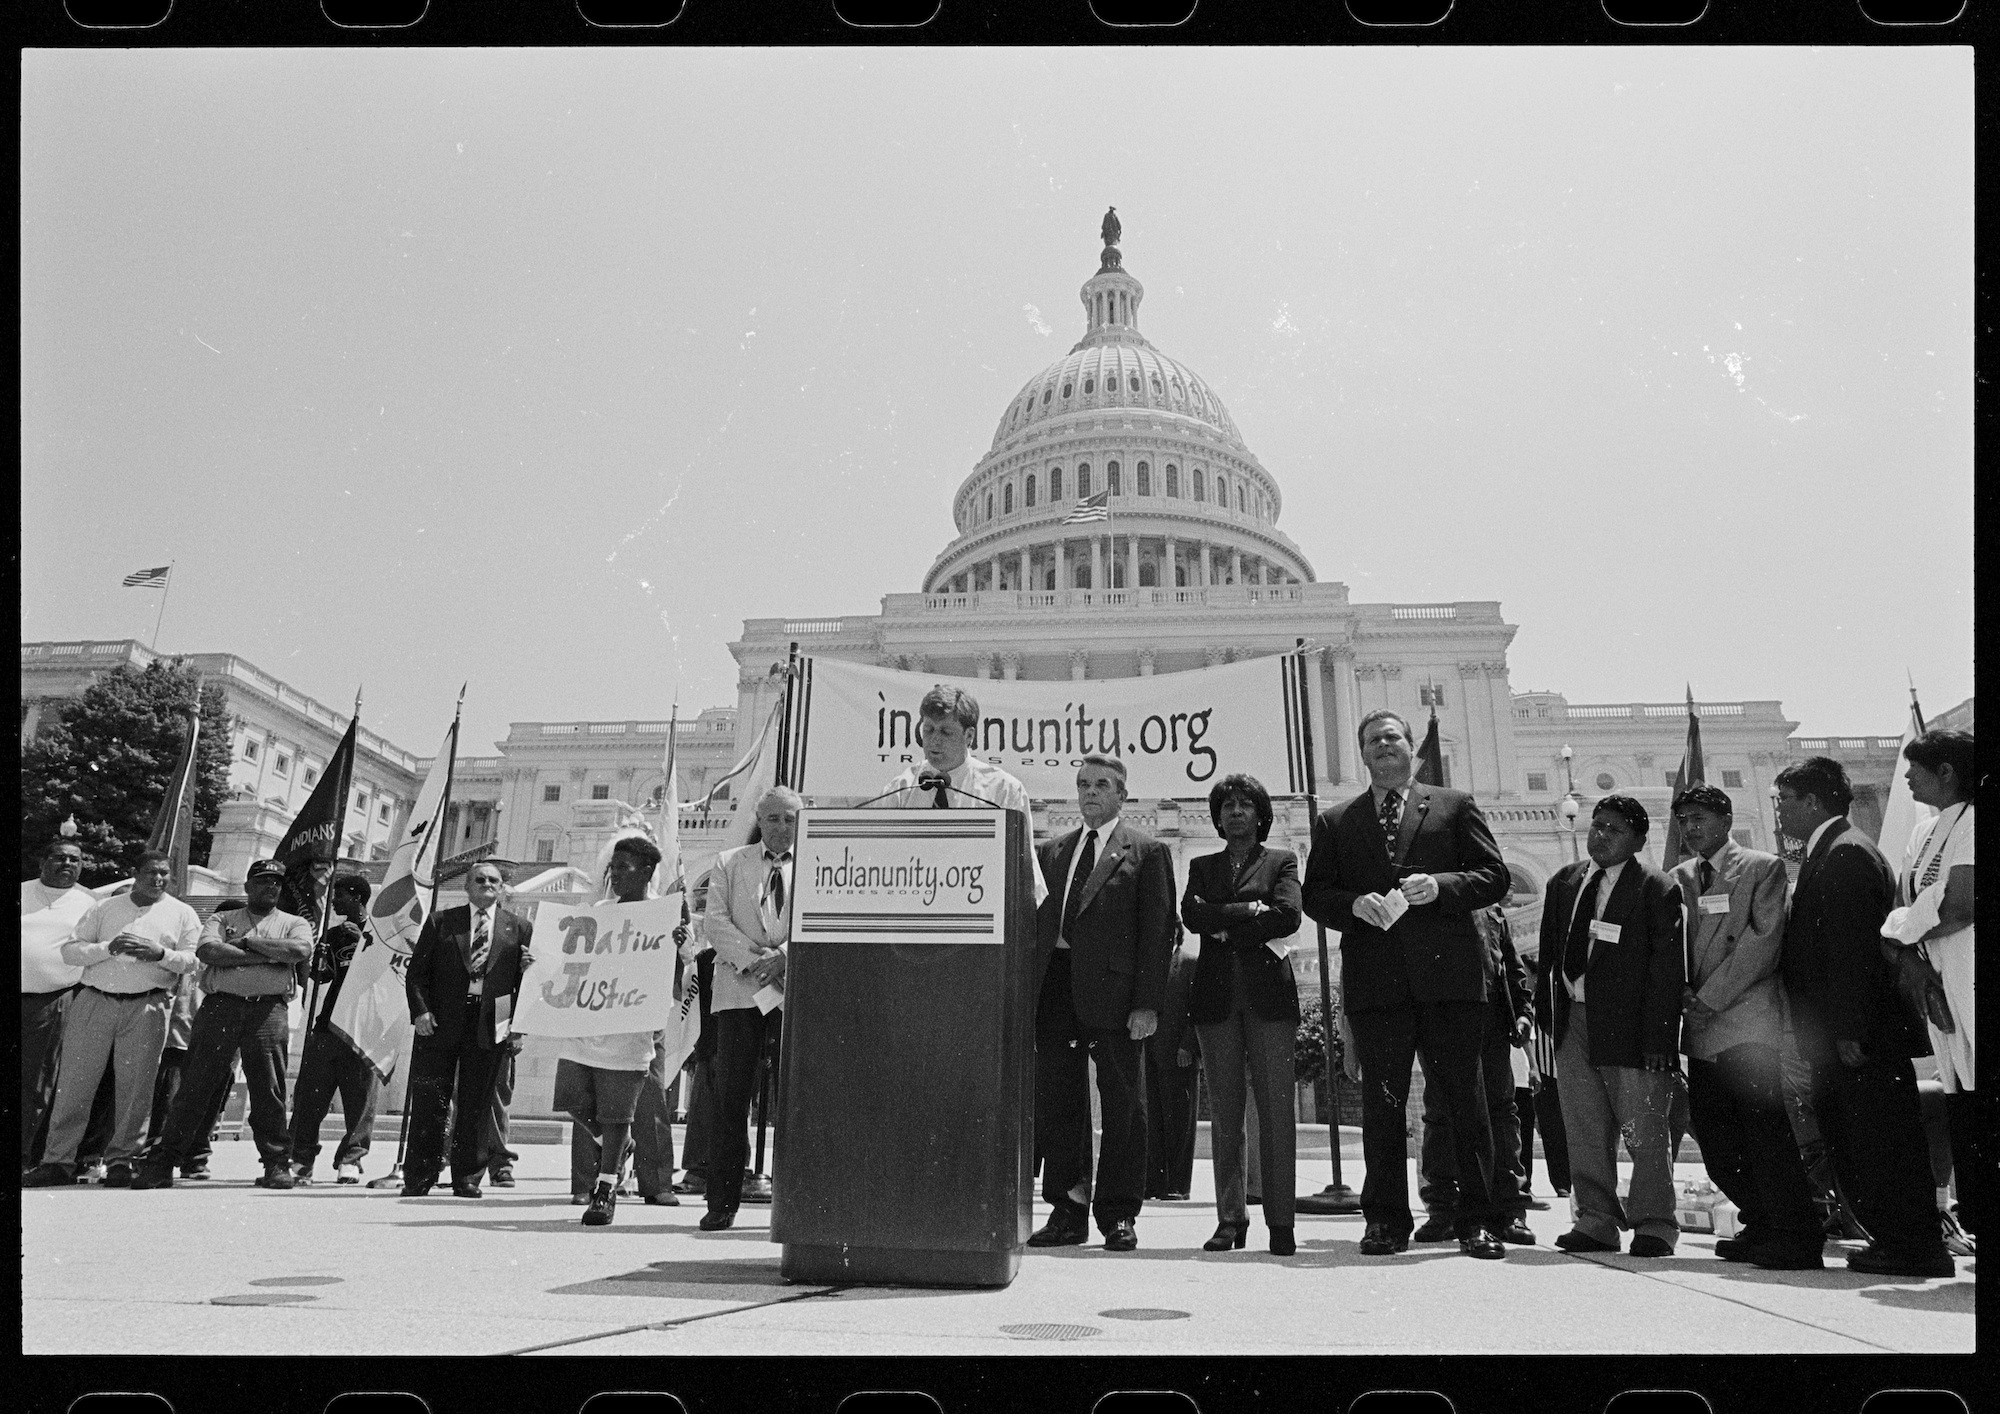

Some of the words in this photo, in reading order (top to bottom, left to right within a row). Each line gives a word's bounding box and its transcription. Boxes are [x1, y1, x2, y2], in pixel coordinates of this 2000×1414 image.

[878, 691, 1217, 782] innunity.org
[877, 754, 1003, 765] TRS
[1021, 757, 1084, 768] 200
[290, 823, 335, 852] INDIANS
[815, 845, 984, 906] indianunity.org
